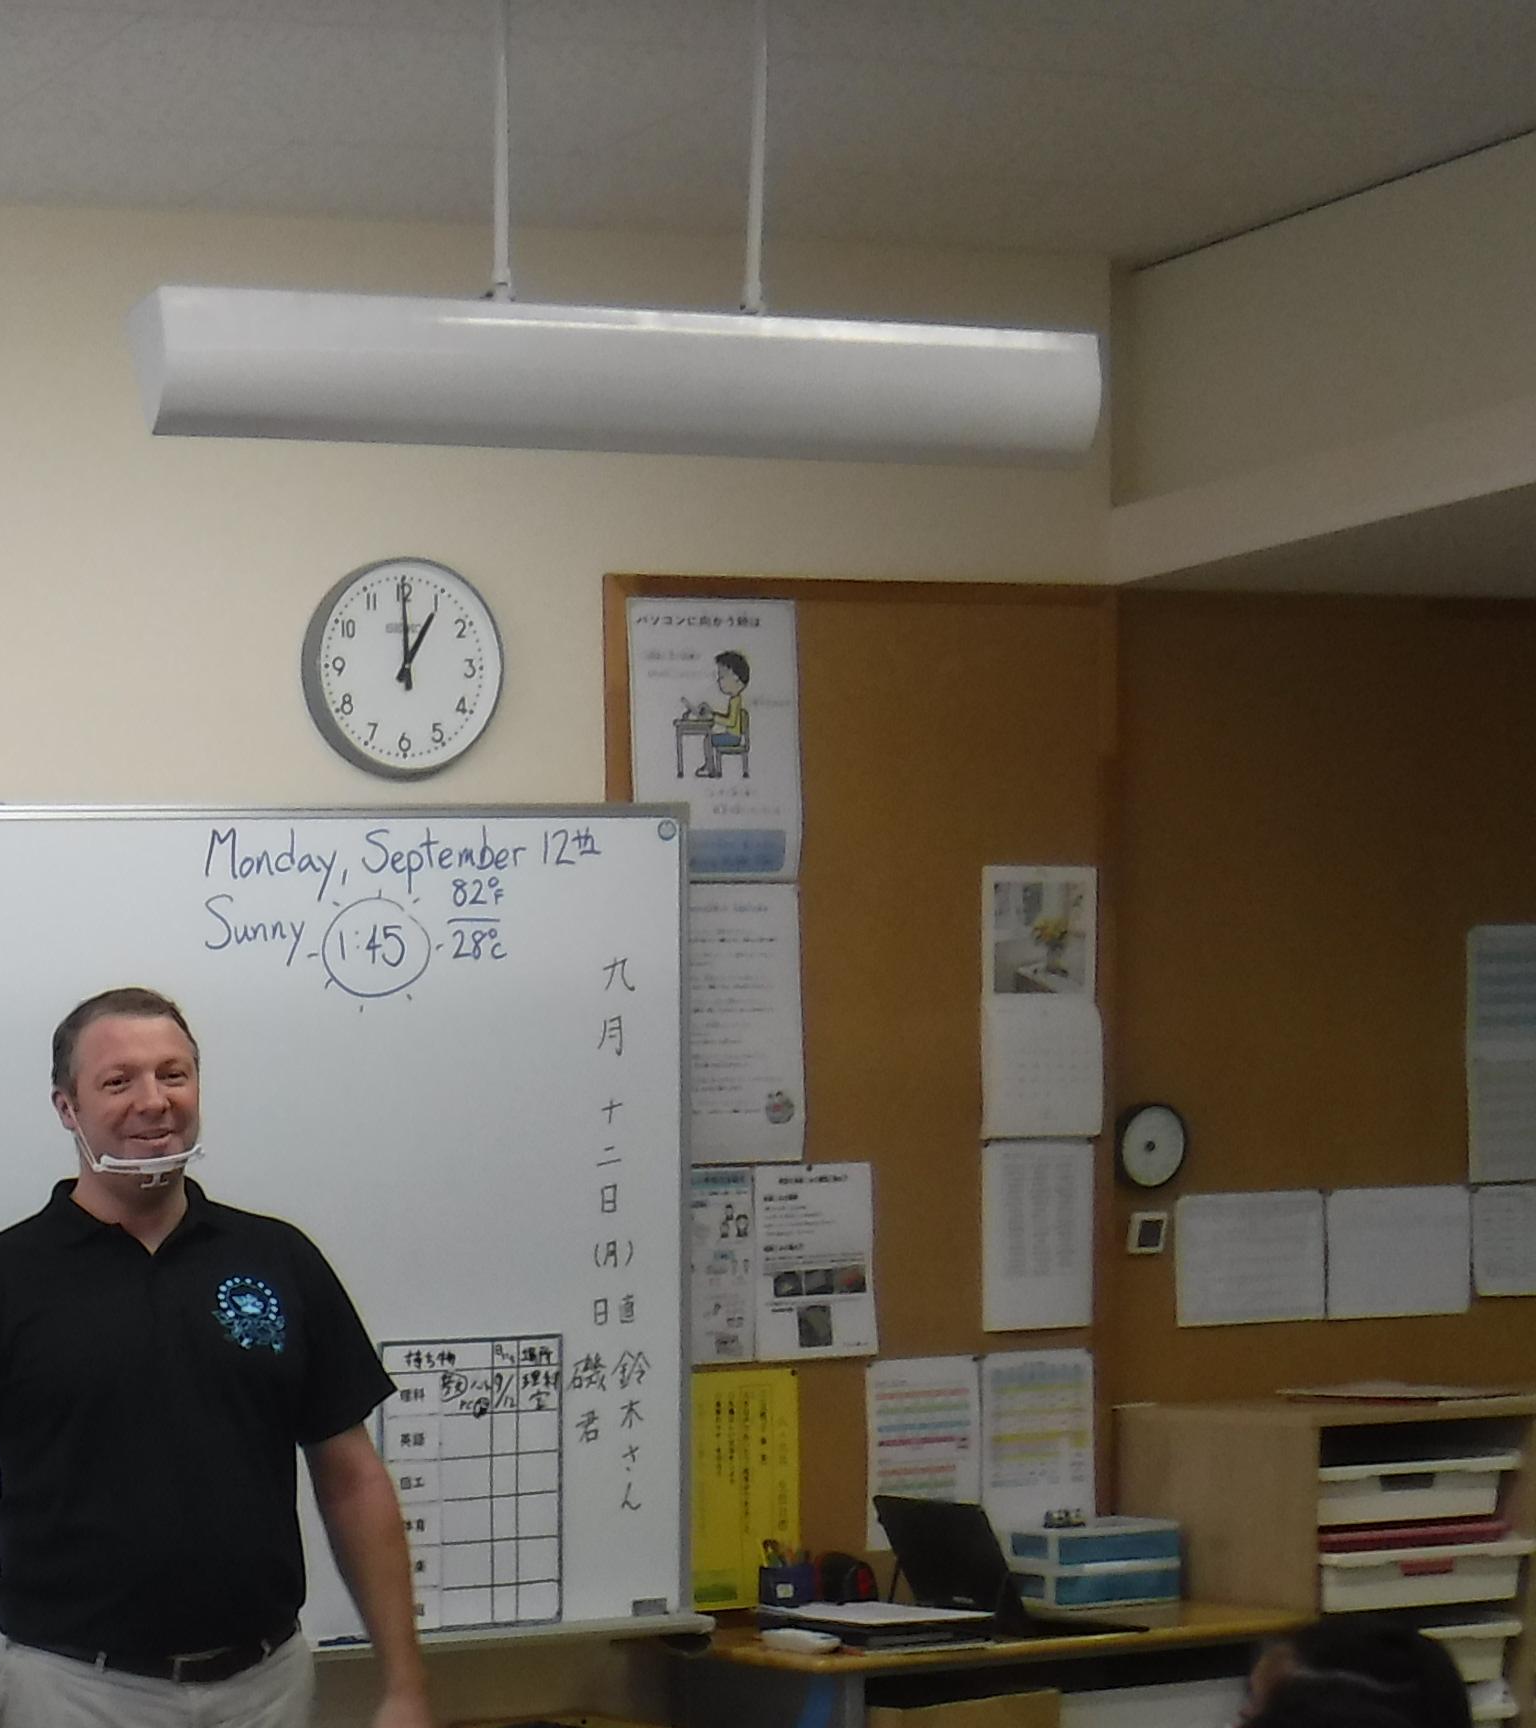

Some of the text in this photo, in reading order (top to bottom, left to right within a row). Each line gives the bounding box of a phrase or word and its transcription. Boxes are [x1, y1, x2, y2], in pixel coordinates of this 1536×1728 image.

[365, 592, 377, 611] 11
[396, 583, 413, 603] 12
[340, 618, 356, 639] 10
[454, 618, 467, 639] 2
[331, 656, 346, 677] 9
[463, 658, 477, 679] 3
[340, 692, 354, 716] 8
[455, 696, 468, 714] 4
[366, 722, 379, 742] 7
[397, 732, 412, 752] 6
[431, 722, 445, 743] 5
[203, 827, 348, 902] Monday,
[361, 828, 528, 895] September
[204, 893, 306, 967] Sunny
[337, 924, 406, 967] 1:45
